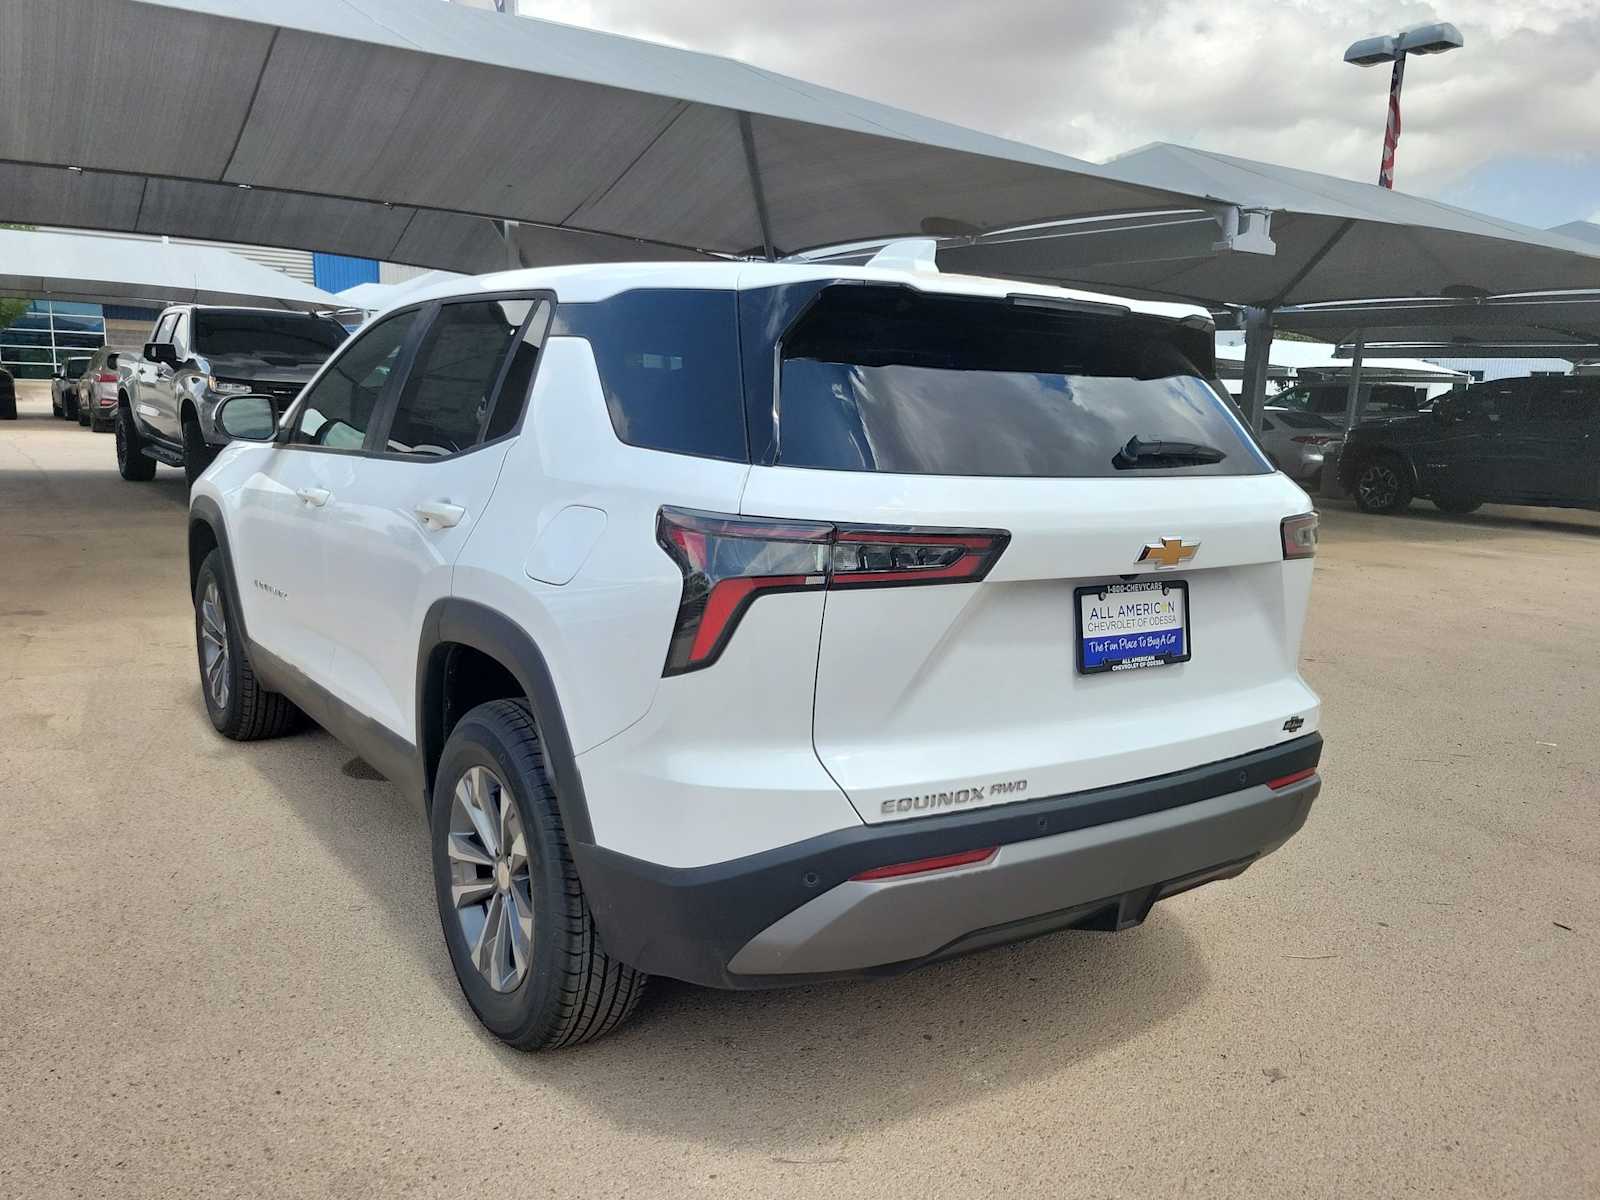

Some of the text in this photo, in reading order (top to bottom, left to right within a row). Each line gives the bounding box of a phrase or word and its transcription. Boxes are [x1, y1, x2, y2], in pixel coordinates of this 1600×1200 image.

[1090, 607, 1114, 620] ALL
[1088, 615, 1176, 632] CHEVROLET OF ODESSA
[1089, 641, 1104, 653] The
[1104, 640, 1118, 652] Fun
[1119, 637, 1137, 650] Place
[1138, 636, 1146, 647] To
[1147, 635, 1160, 649] Buy
[1160, 635, 1166, 645] A
[880, 786, 985, 814] EQUINOX
